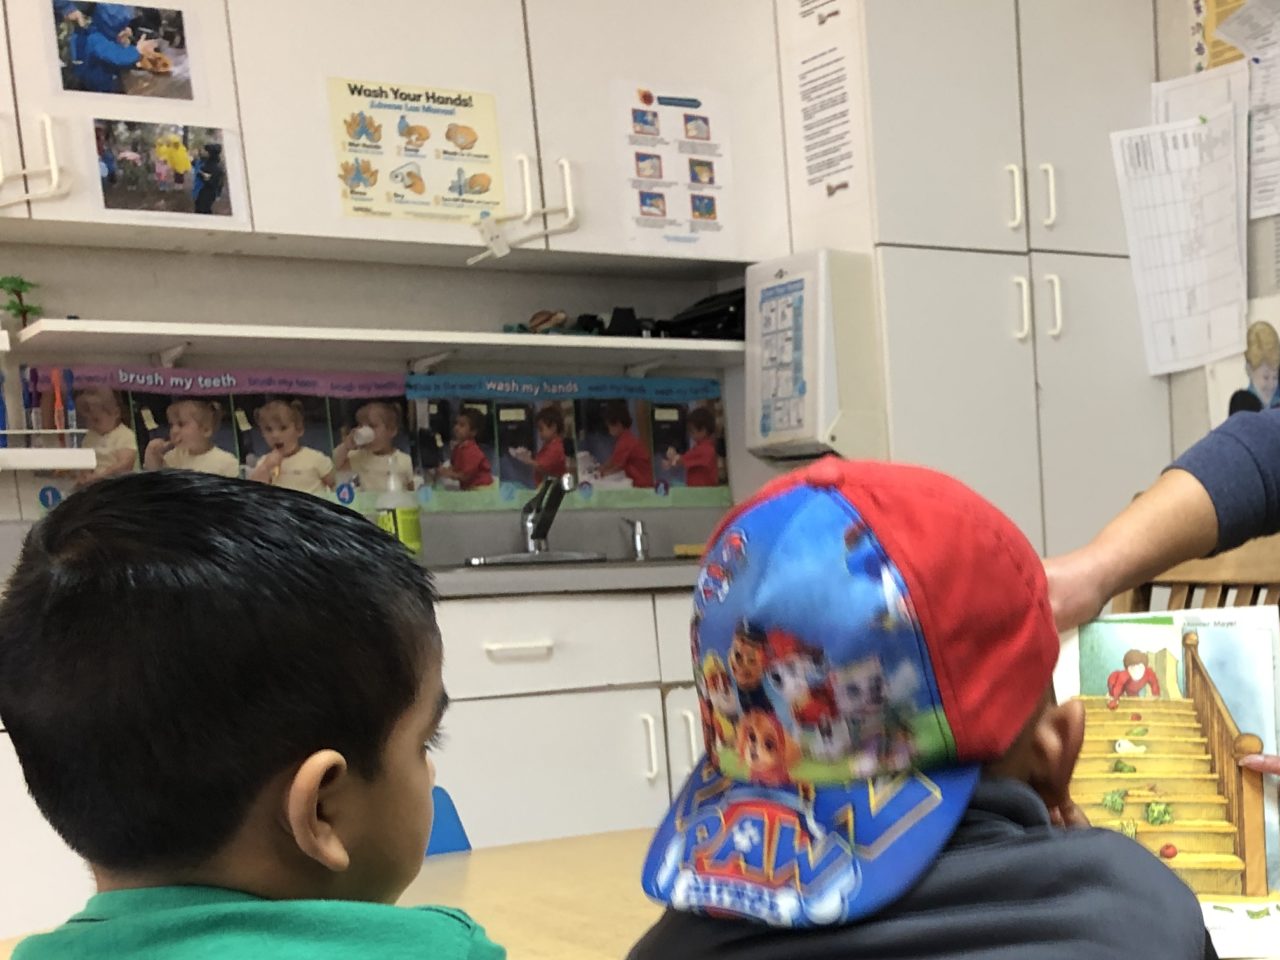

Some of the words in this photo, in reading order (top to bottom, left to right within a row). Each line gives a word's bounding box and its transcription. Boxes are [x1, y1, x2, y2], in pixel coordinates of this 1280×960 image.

[347, 83, 388, 99] Wash
[390, 87, 422, 102] Your
[425, 91, 473, 108] Hands!
[118, 368, 164, 387] brush
[170, 375, 193, 391] my
[198, 373, 237, 388] teeth
[485, 379, 519, 393] wash
[521, 383, 540, 396] my
[543, 380, 579, 394] hands
